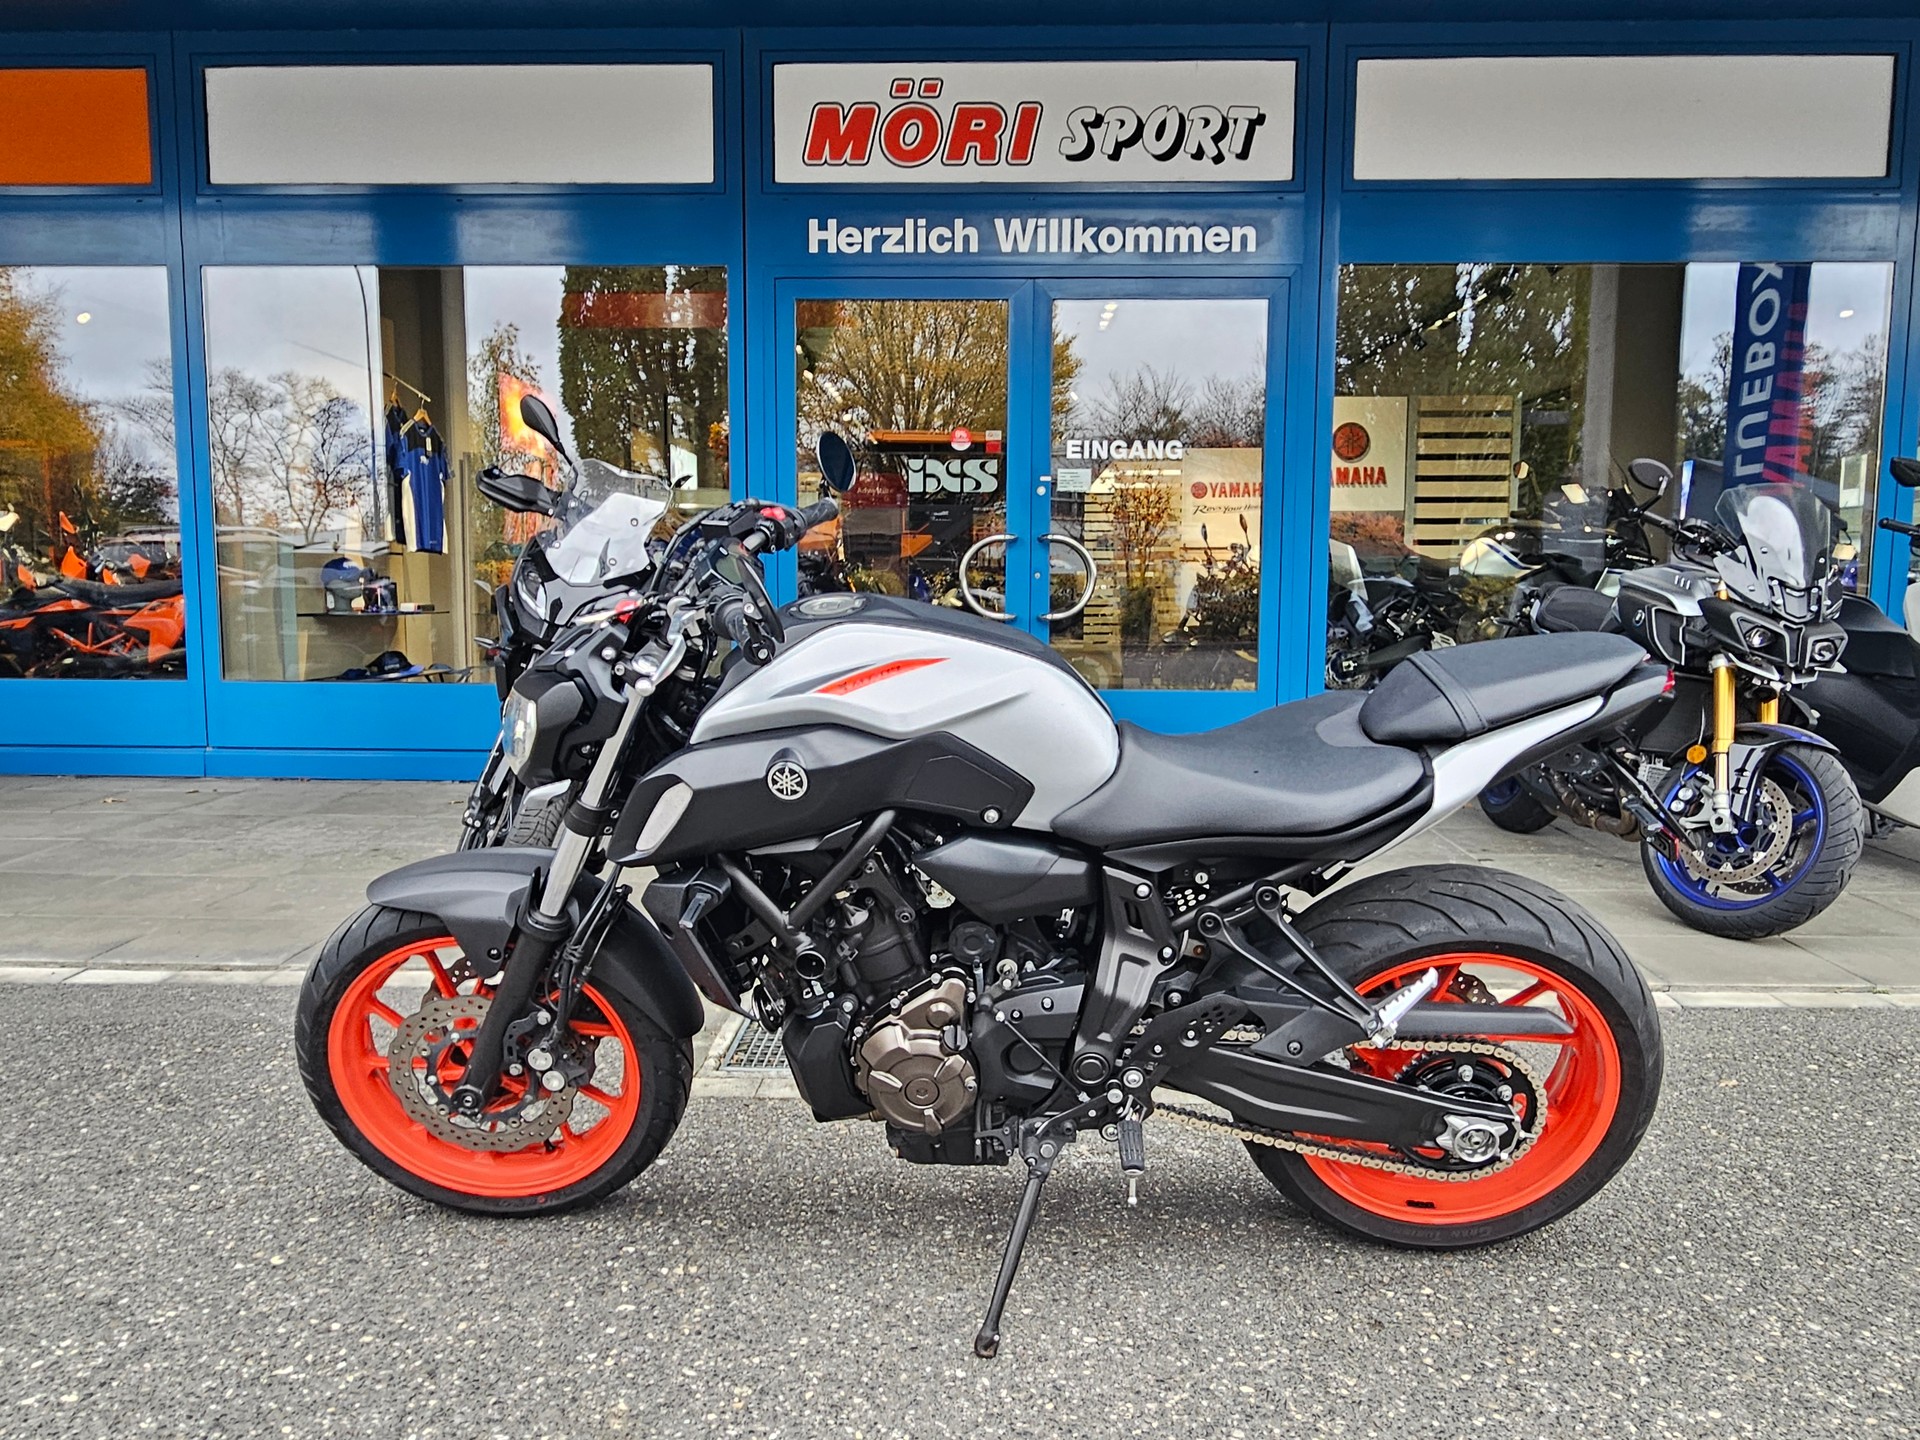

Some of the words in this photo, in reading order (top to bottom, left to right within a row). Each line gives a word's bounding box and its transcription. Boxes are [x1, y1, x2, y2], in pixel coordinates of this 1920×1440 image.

[802, 78, 1043, 167] MÖRI
[1059, 105, 1267, 165] SPORT
[808, 218, 979, 254] Herzlich
[994, 218, 1257, 253] Willkommen
[1066, 439, 1183, 459] EINGANG
[1331, 466, 1388, 487] MAHA
[1209, 482, 1263, 498] YAMAH
